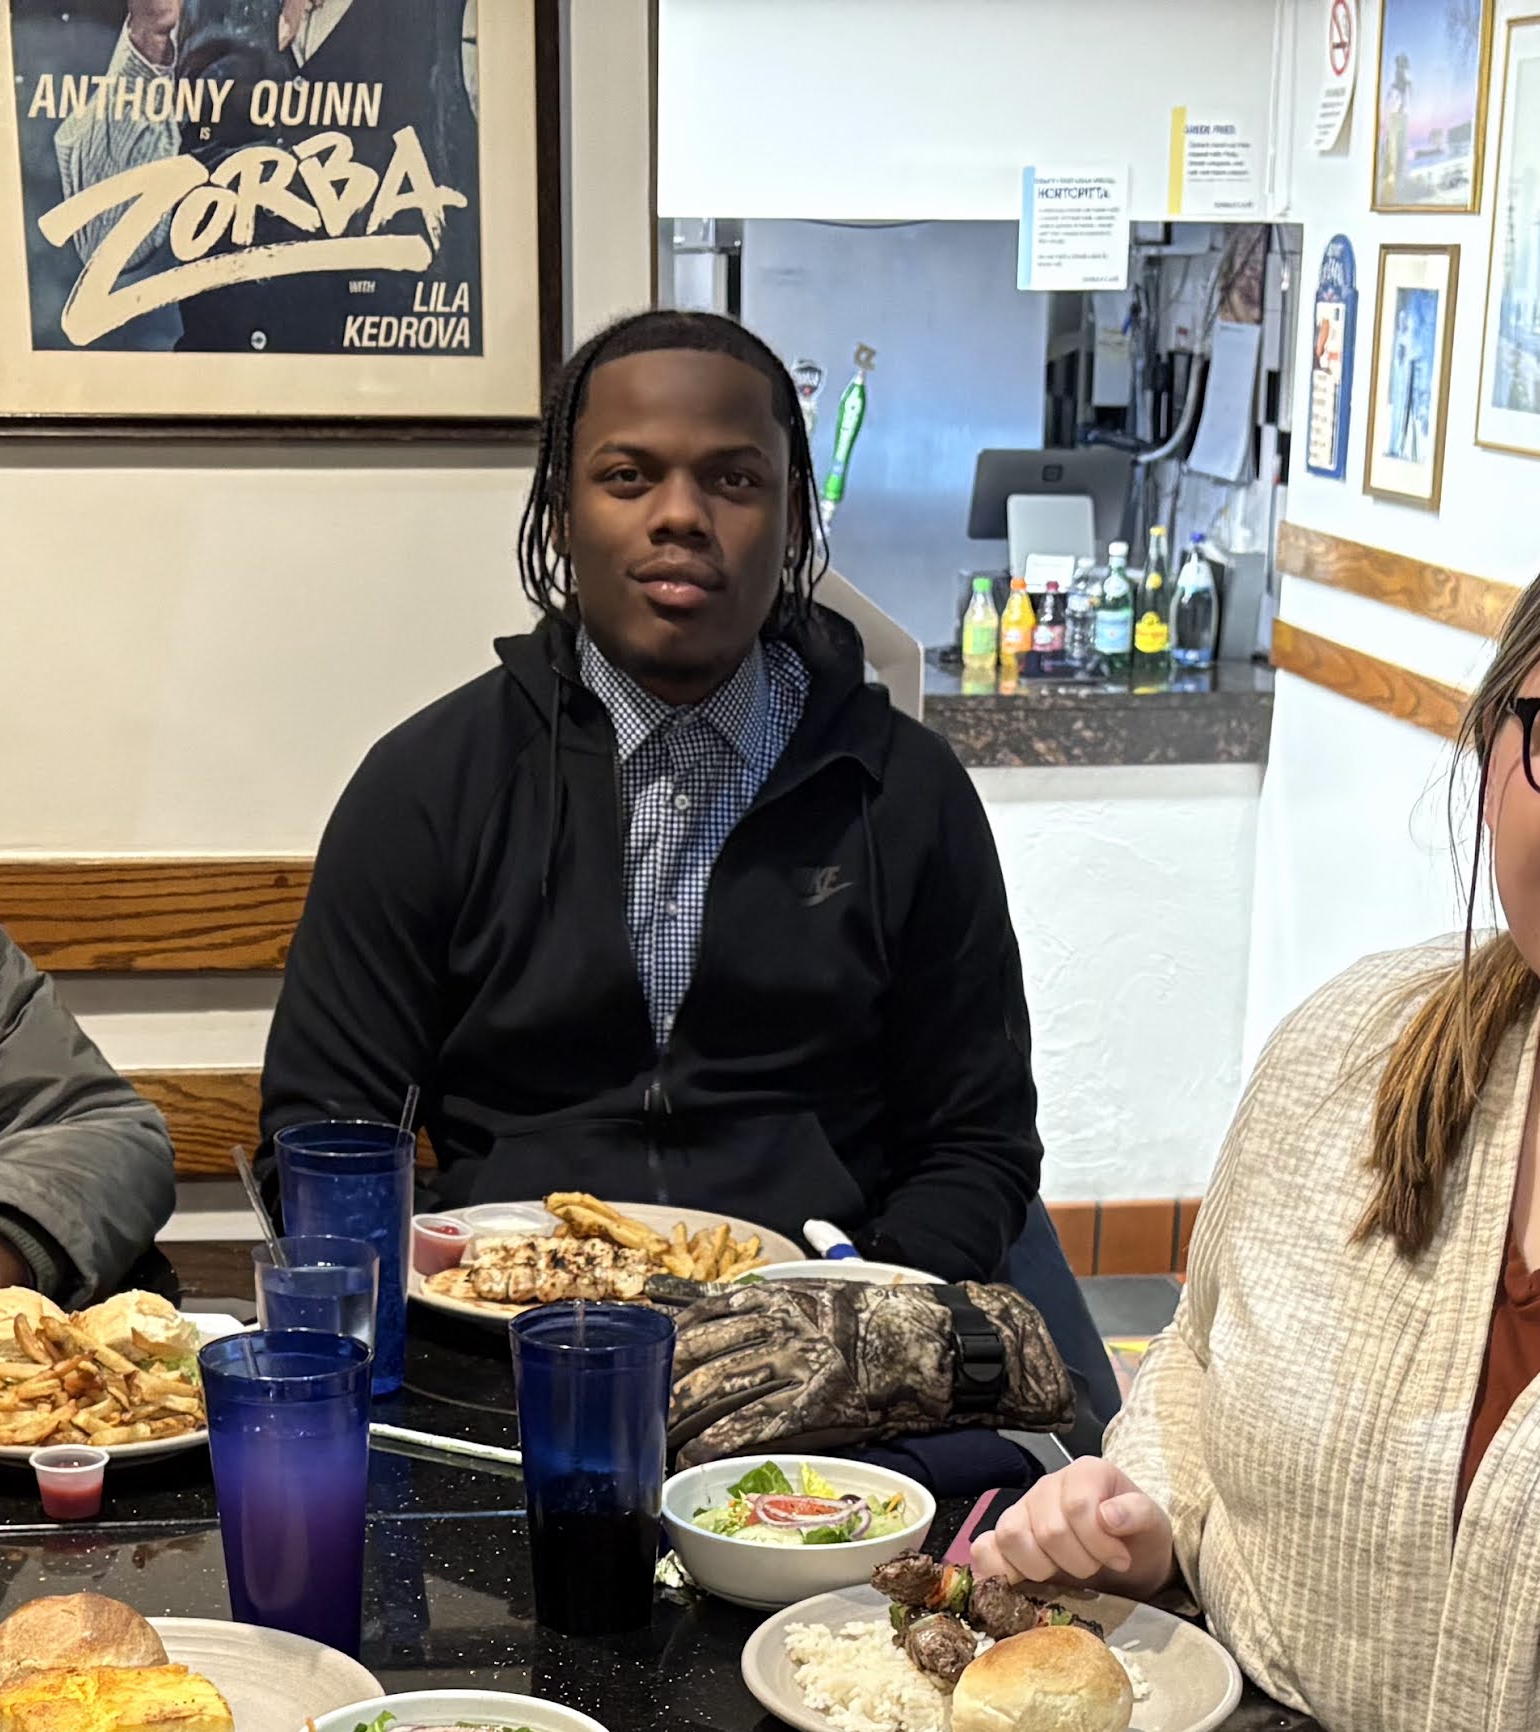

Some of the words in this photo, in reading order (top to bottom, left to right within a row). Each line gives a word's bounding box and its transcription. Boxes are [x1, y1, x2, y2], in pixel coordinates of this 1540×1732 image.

[28, 73, 236, 124] ANTHONY
[249, 79, 383, 128] QUINN
[199, 127, 211, 140] IS
[37, 125, 468, 346] ZORBA
[348, 280, 376, 294] WITH
[412, 281, 470, 313] LILA
[342, 315, 470, 349] KEDROVA
